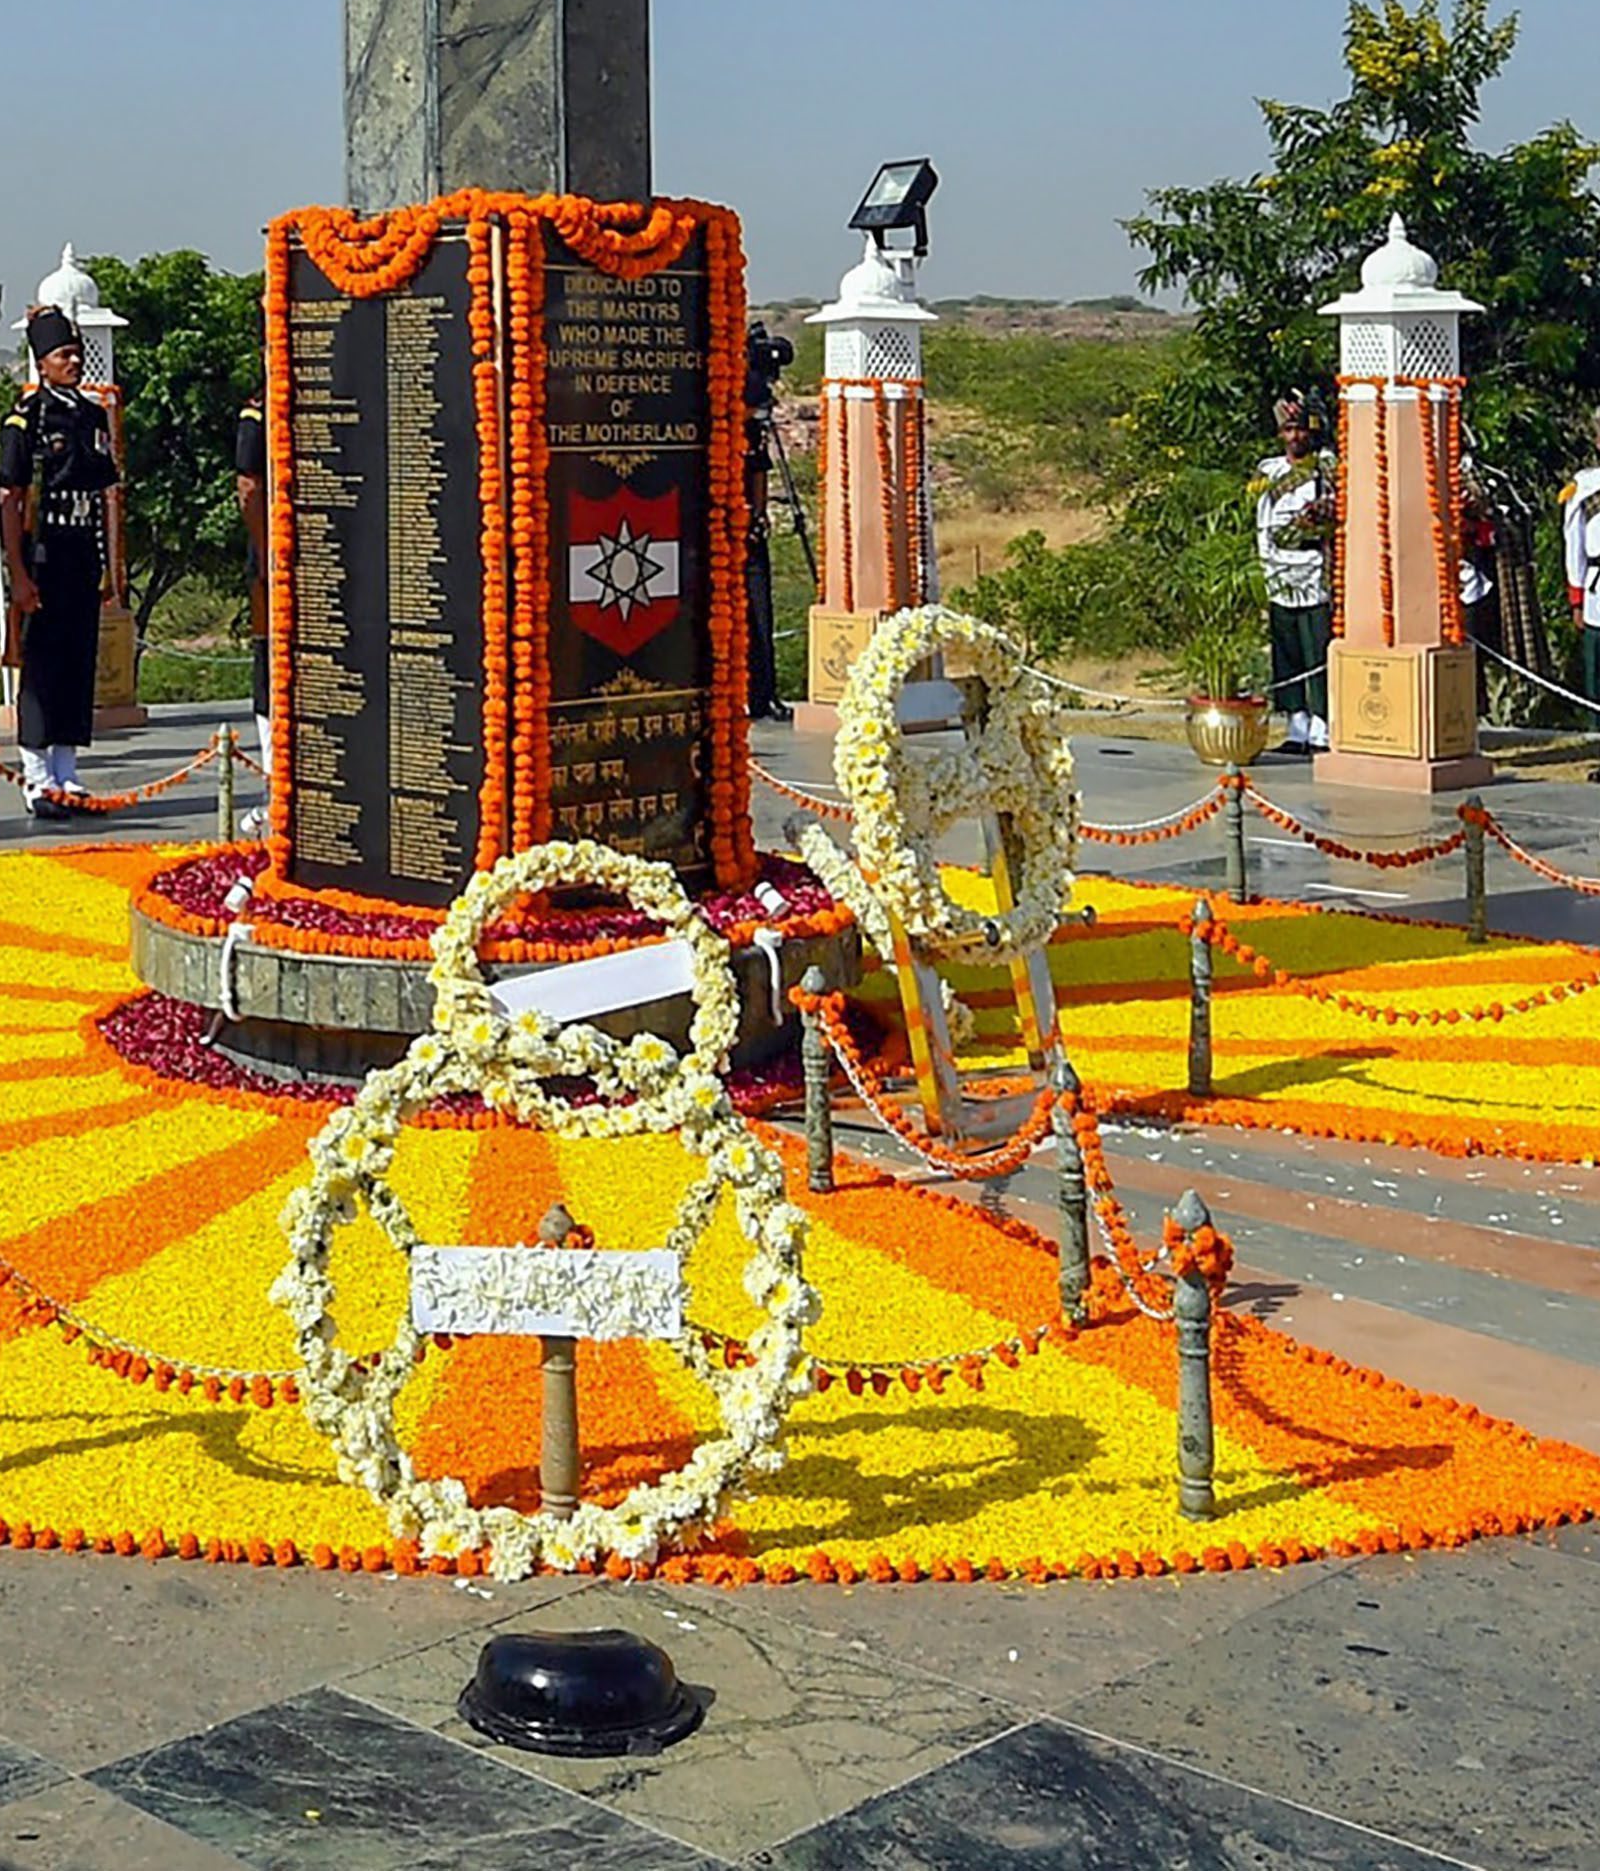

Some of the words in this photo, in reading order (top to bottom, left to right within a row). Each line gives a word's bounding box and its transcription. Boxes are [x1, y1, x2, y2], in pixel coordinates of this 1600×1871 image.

[563, 275, 657, 297] DEDICATED
[658, 279, 682, 298] TO
[565, 300, 599, 320] THE
[602, 301, 681, 321] MARTYRS
[558, 324, 600, 344] WHO
[603, 326, 650, 345] MADE
[655, 327, 687, 346] THE
[549, 349, 619, 369] UPREME
[575, 374, 592, 393] IN
[595, 374, 672, 394] DEFENCE
[610, 399, 634, 418] OF
[549, 423, 583, 443] THE
[585, 423, 698, 443] MOTHERLAND
